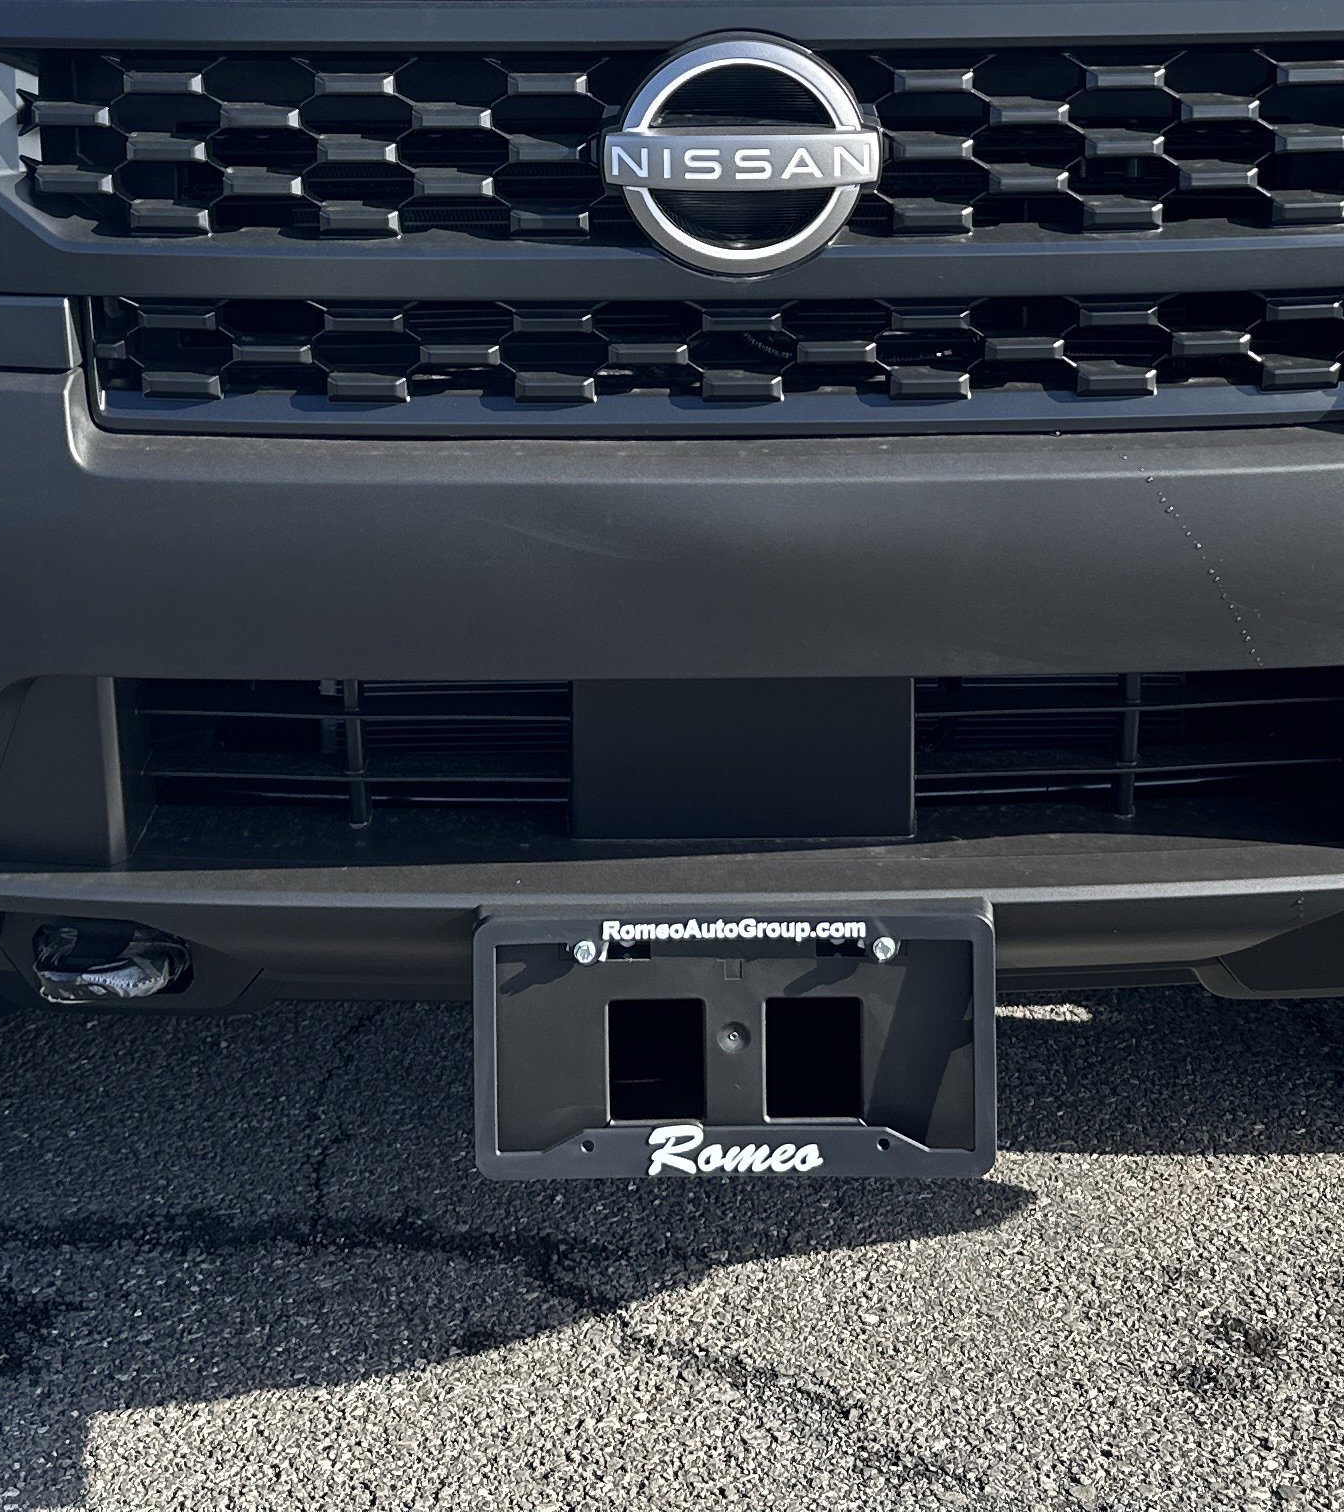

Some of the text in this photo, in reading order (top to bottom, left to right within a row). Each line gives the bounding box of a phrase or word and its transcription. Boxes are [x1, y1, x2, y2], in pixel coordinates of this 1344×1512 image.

[610, 144, 872, 180] NISSAN
[602, 918, 867, 942] RomeoAutoGroup.com
[647, 1124, 824, 1176] Romeo
